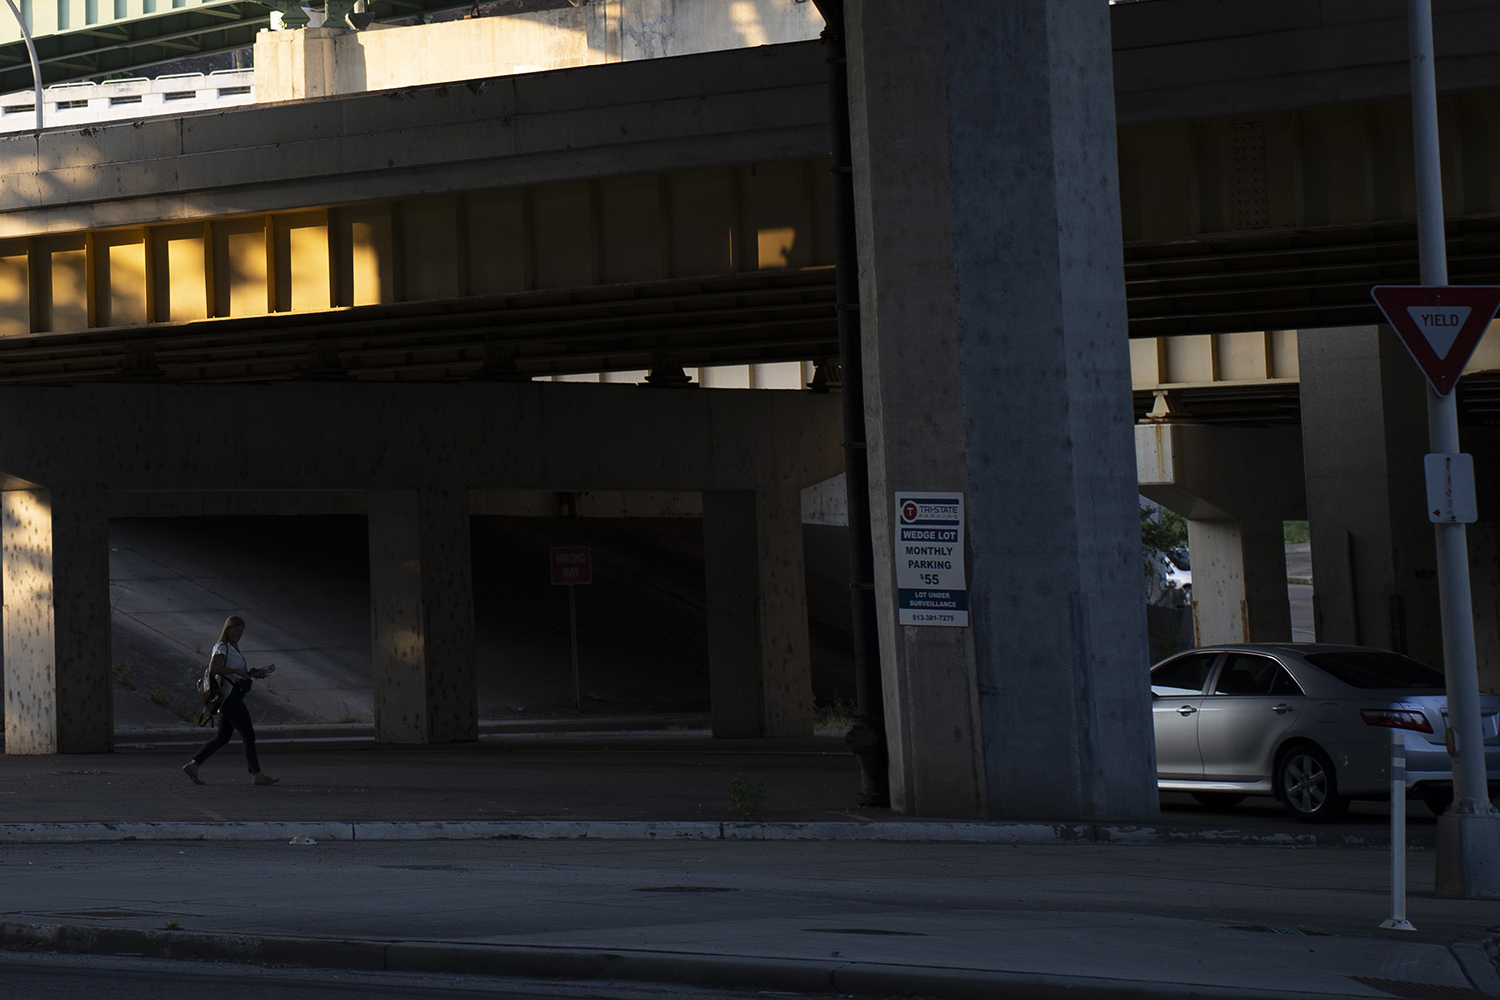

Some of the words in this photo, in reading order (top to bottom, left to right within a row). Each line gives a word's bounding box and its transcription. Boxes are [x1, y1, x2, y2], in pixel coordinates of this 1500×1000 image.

[1421, 314, 1459, 326] YIELD
[907, 507, 914, 516] T
[919, 506, 958, 514] TRI-STATE
[903, 530, 936, 540] WEDGE
[938, 531, 956, 540] LOT
[905, 546, 953, 556] MONTHLY
[556, 552, 586, 564] WRONG
[908, 560, 952, 570] PARKING
[563, 567, 580, 577] WAY
[920, 573, 940, 585] $55
[909, 600, 957, 608] SURVEILLANCE
[912, 614, 955, 622] 513-381-7275
